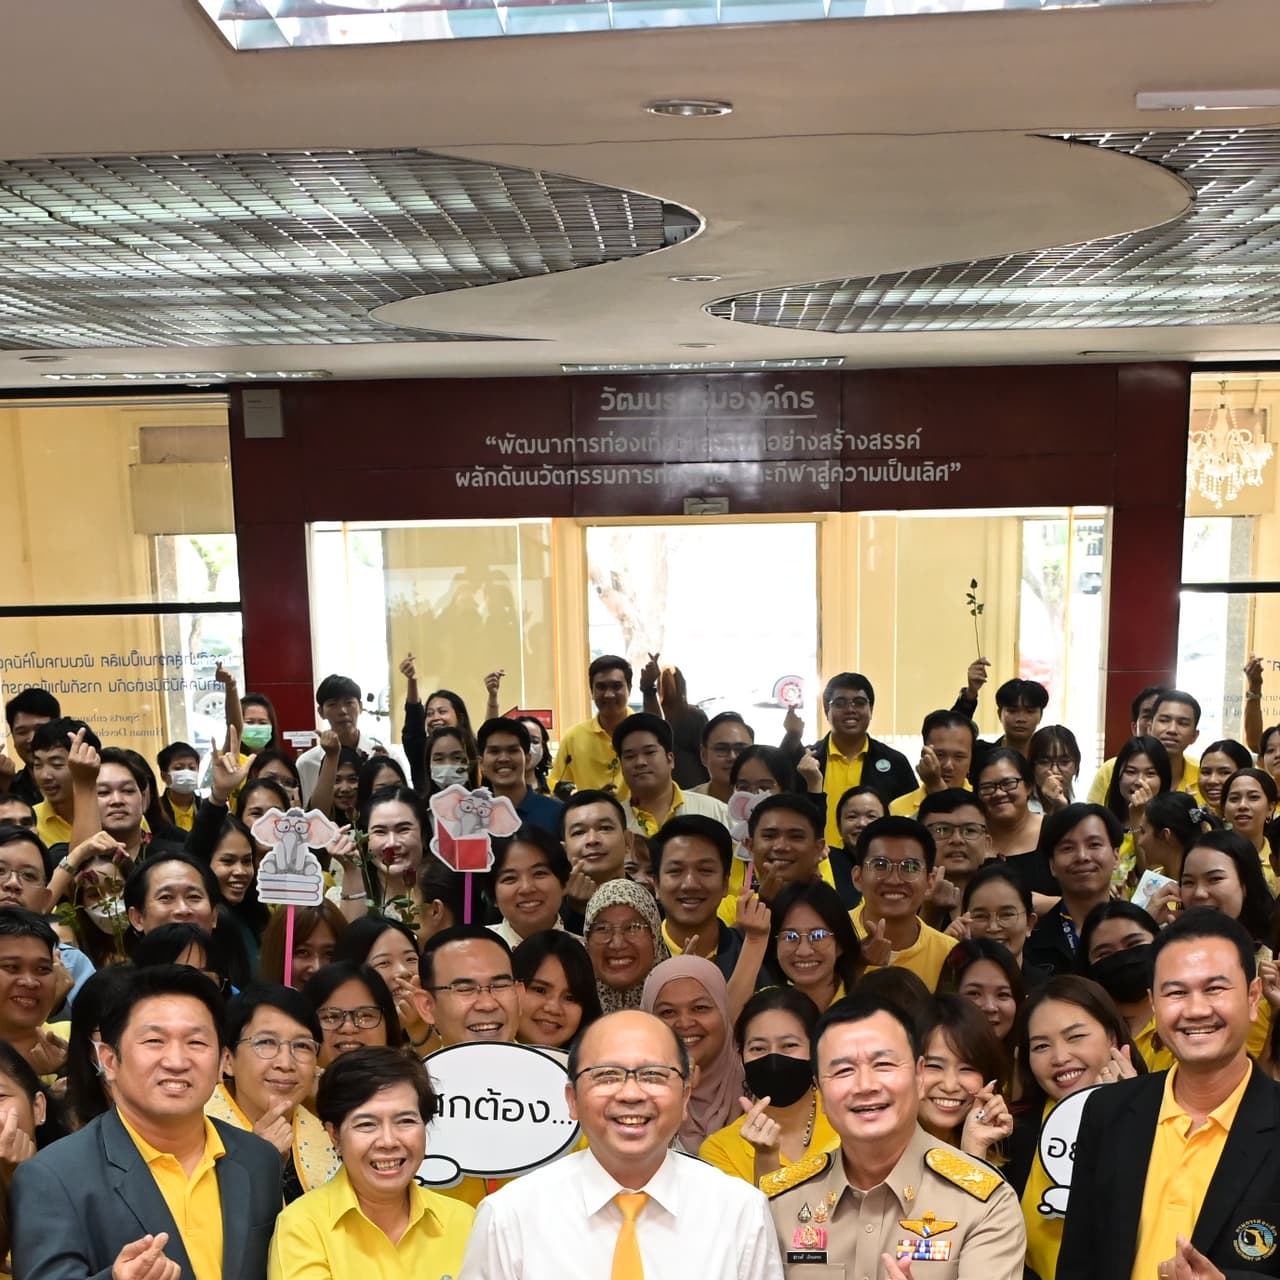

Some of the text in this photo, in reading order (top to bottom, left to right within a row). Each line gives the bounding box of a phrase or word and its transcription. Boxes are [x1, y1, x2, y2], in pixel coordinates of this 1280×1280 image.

[599, 384, 815, 413] วัฒนธมองค์กร
